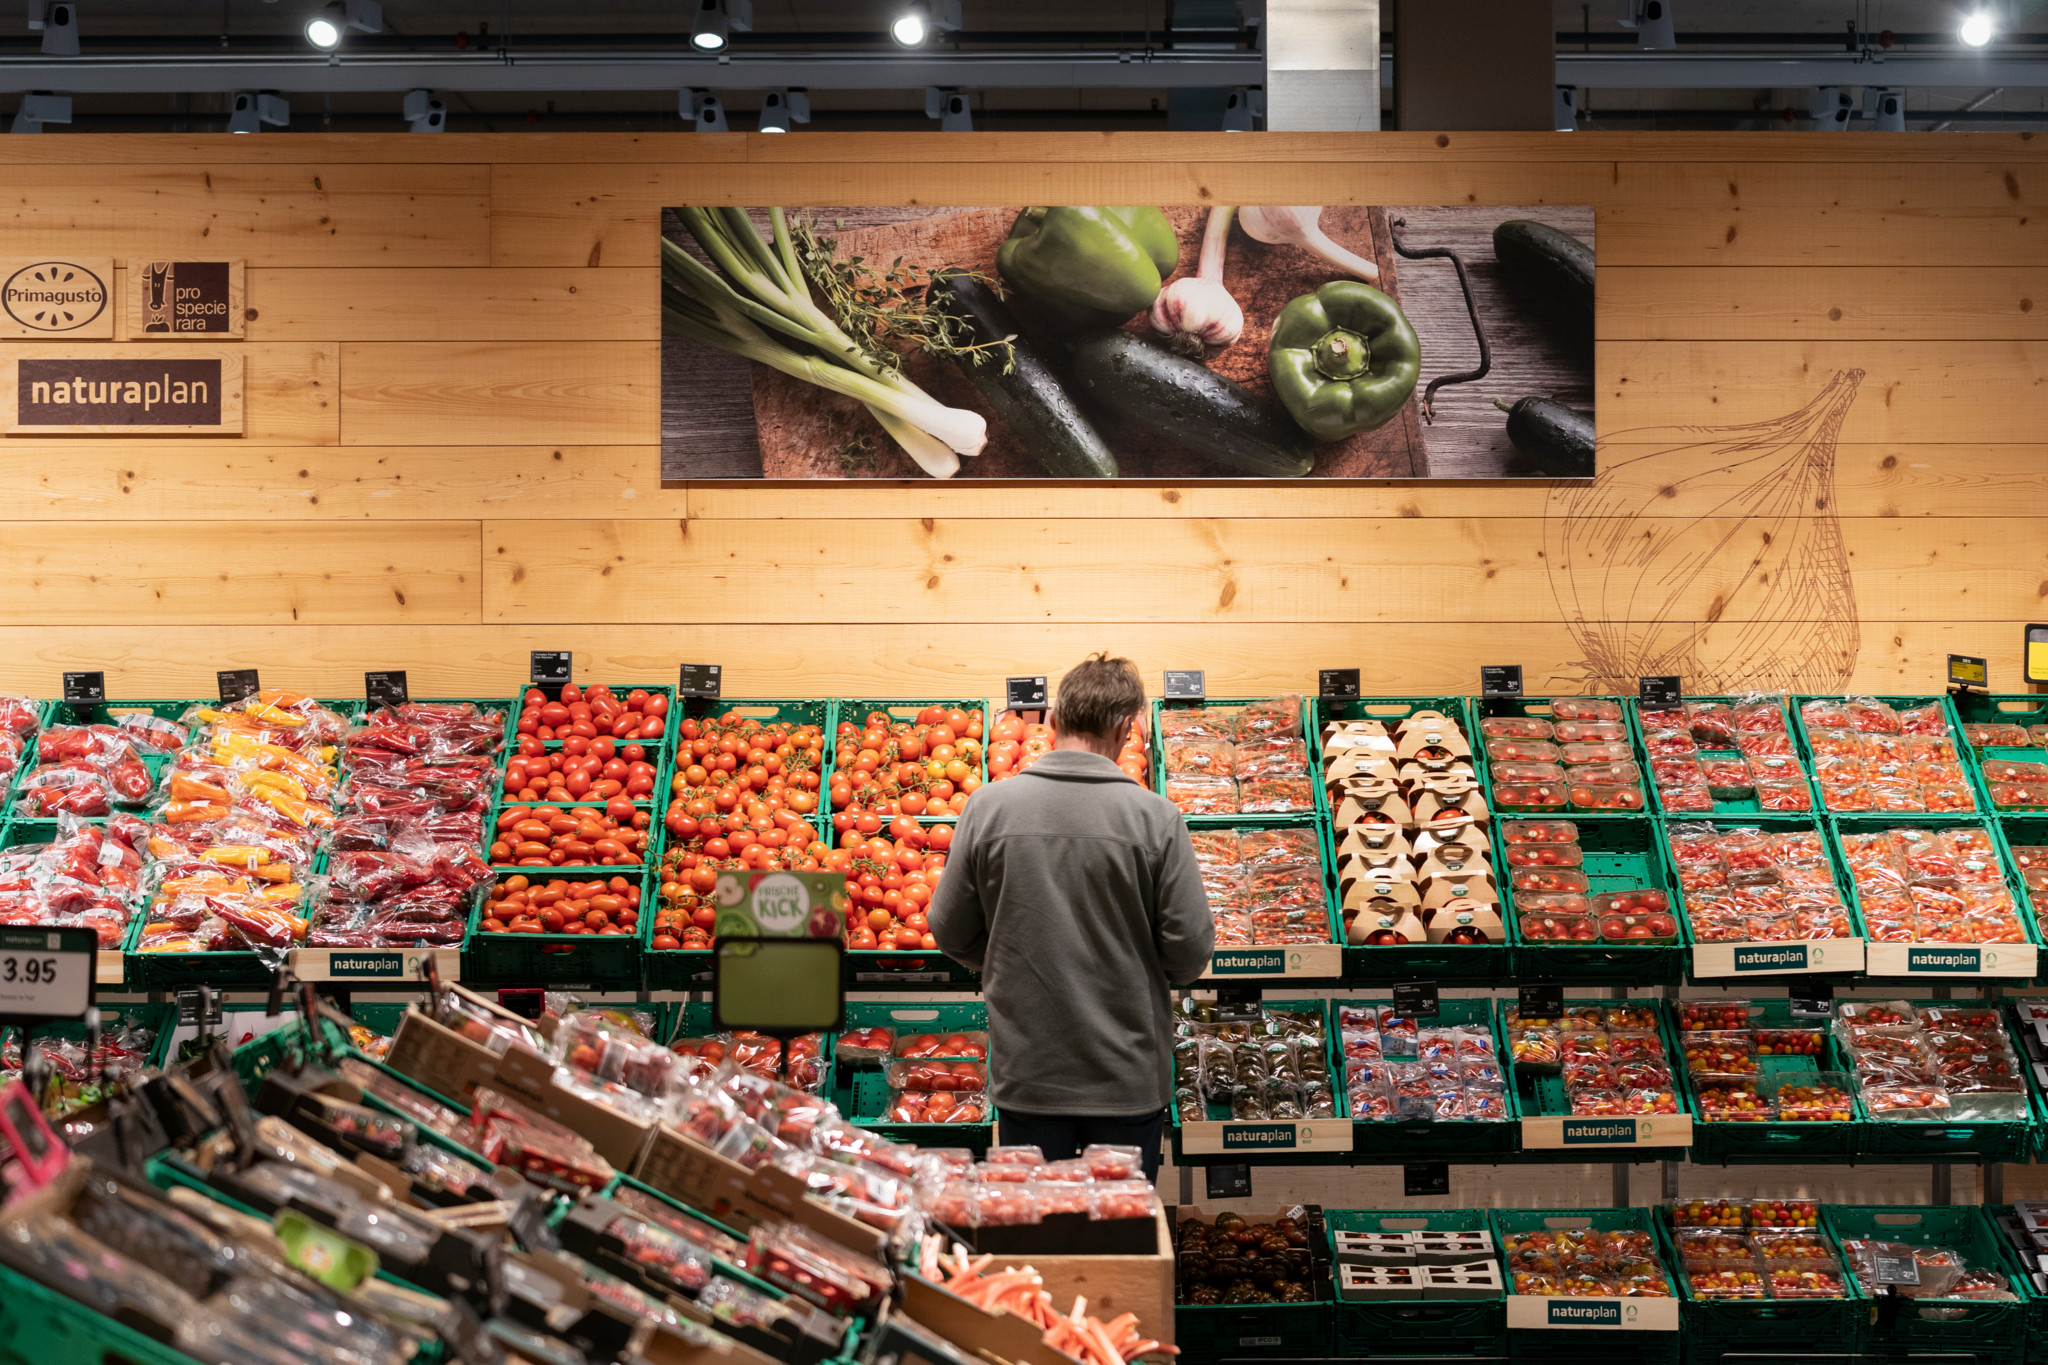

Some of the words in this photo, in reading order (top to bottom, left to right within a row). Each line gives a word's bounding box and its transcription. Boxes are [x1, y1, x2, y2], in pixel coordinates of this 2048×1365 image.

[7, 289, 102, 305] Primagusto
[175, 285, 200, 300] pro
[176, 301, 227, 316] specie
[176, 317, 206, 331] rara
[31, 373, 208, 411] naturaplan
[759, 898, 804, 918] KICK
[334, 957, 399, 972] naturaplan
[1216, 954, 1281, 969] naturaplan
[1738, 950, 1804, 965] naturaplan
[1912, 953, 1977, 967] naturaplan
[3, 957, 57, 984] 3.95
[1227, 1129, 1292, 1143] naturaplan
[1567, 1124, 1632, 1138] naturaplan
[1552, 1305, 1617, 1320] naturaplan
